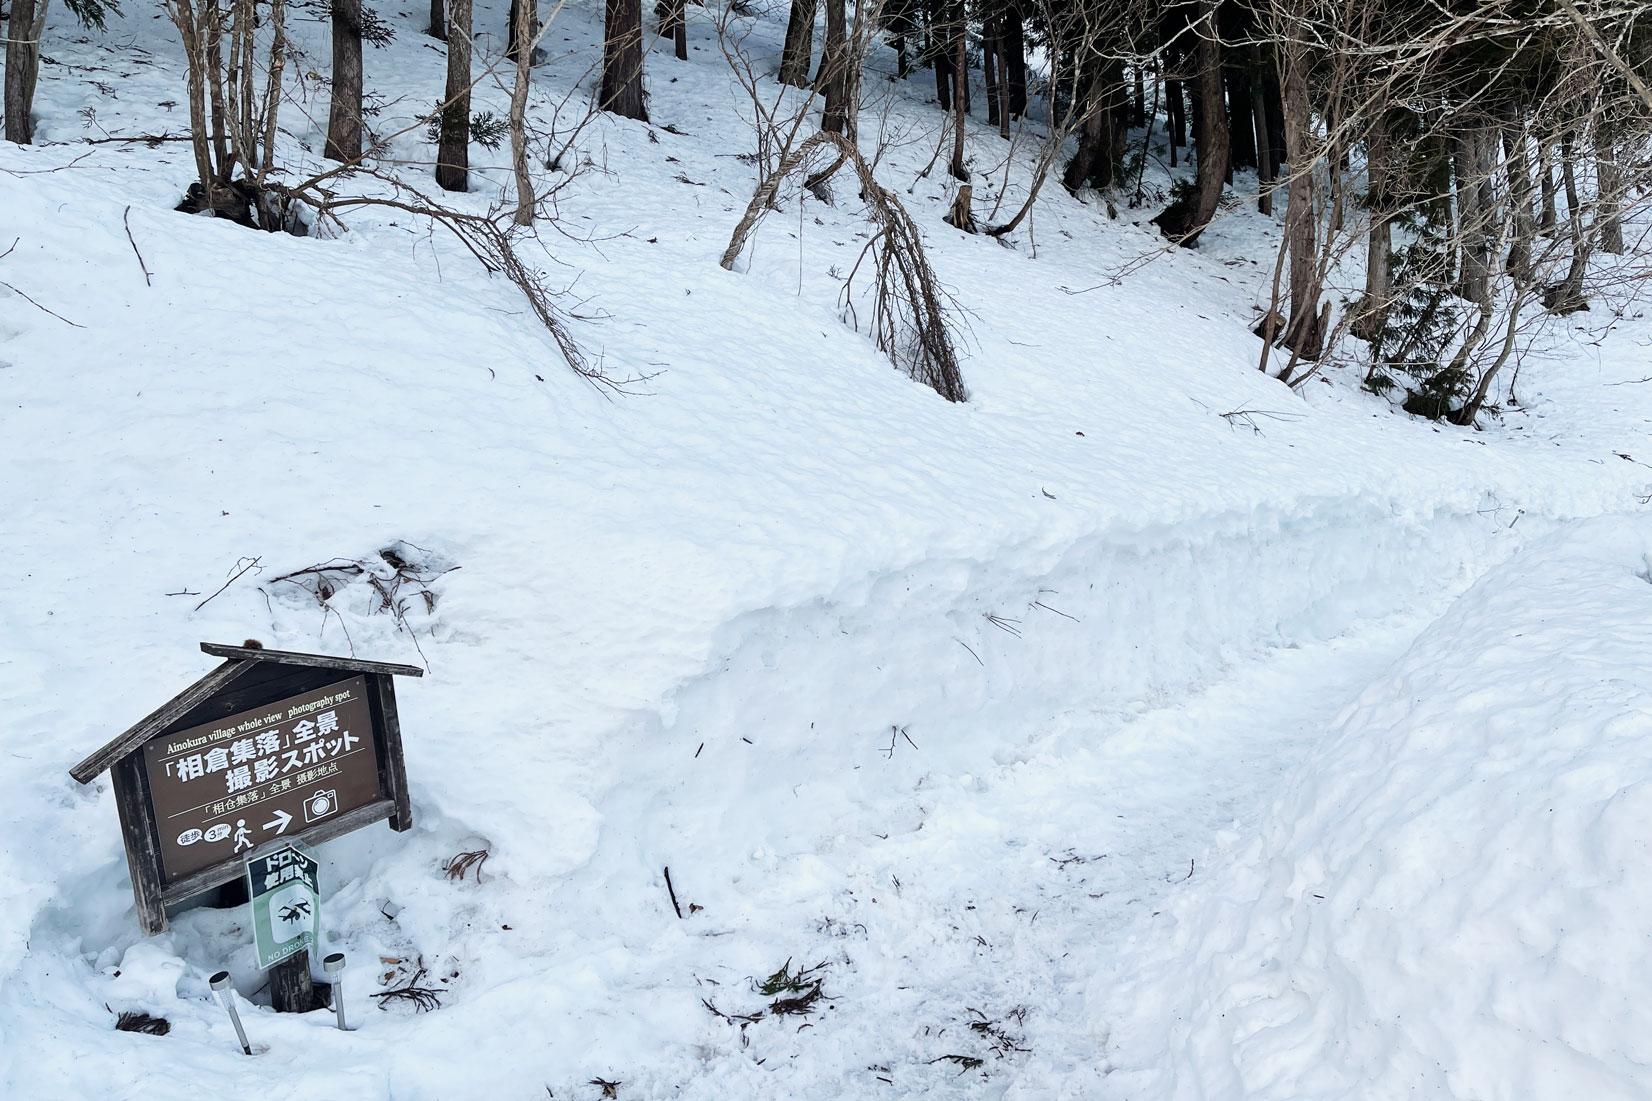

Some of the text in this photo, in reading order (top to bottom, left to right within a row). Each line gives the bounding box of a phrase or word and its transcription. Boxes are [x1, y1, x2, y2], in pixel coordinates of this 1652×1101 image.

[165, 710, 340, 783] 「相倉集落」全景
[167, 689, 351, 755] Ainokura village whole view photography spot
[225, 730, 360, 793] 撮影スポット
[208, 829, 217, 840] 3
[268, 951, 280, 962] NO
